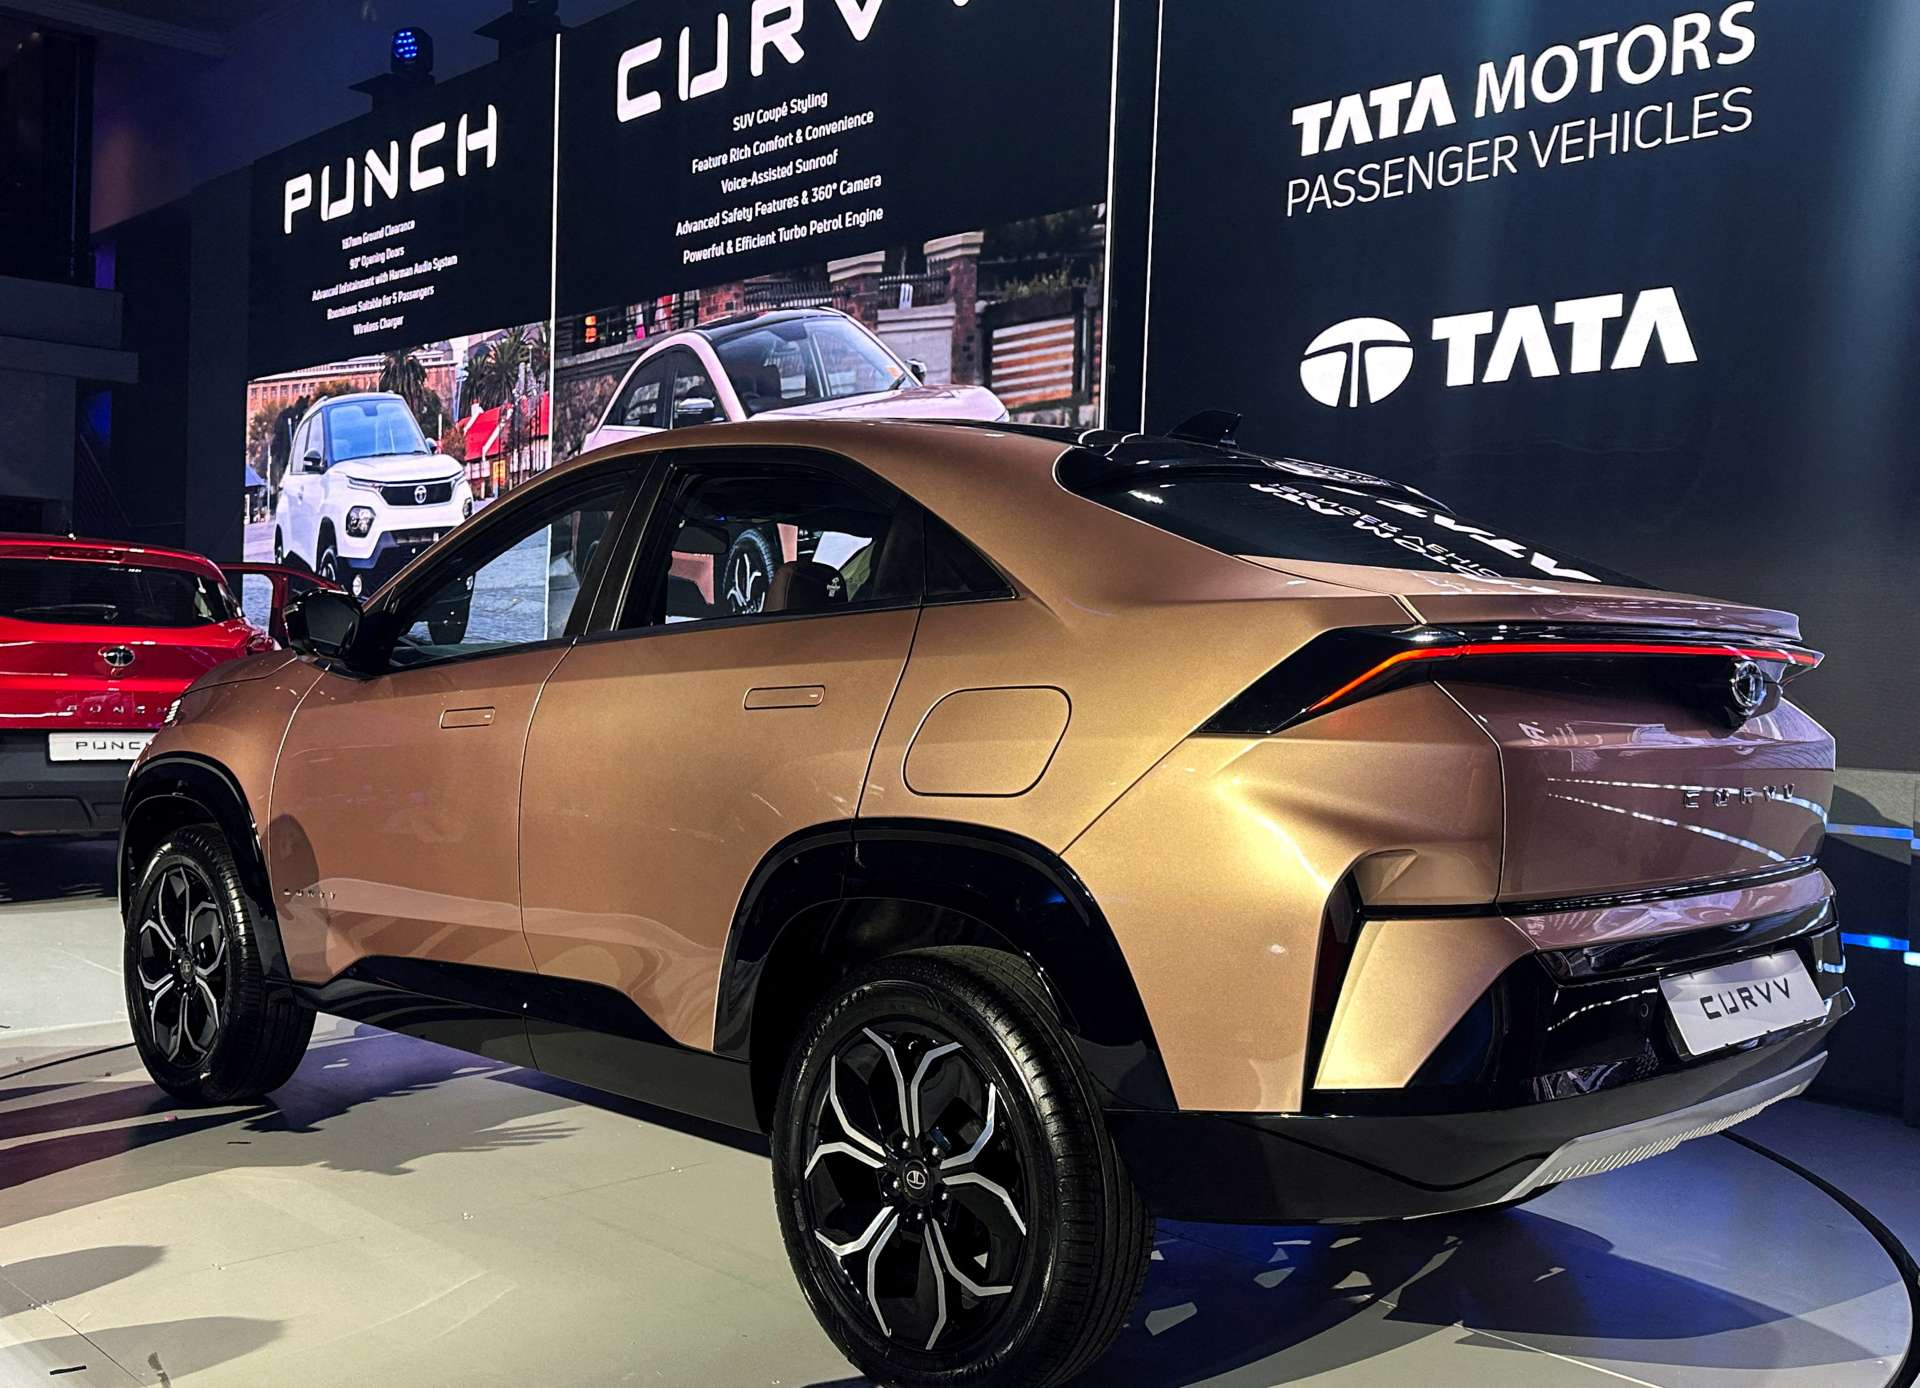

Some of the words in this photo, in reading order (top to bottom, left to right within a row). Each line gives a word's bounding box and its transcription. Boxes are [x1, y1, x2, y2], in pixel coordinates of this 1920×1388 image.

[617, 0, 971, 123] CURV
[1292, 73, 1457, 157] TATA
[1474, 0, 1756, 119] MOTORS
[733, 111, 755, 131] SUV
[756, 101, 788, 124] Coupé
[790, 92, 828, 114] Styling
[692, 153, 728, 174] Feature
[729, 144, 751, 163] Rich
[752, 132, 794, 156] Comfort
[795, 128, 803, 144] &
[805, 111, 874, 141] Convenience
[1287, 134, 1519, 217] PASSENGER
[1529, 86, 1753, 168] VEHICLES
[284, 104, 498, 234] PUNCH
[721, 160, 793, 194] Voice-Assisted
[795, 148, 839, 174] Sunroof
[676, 212, 720, 237] Advanced
[721, 207, 753, 225] Safety
[754, 195, 799, 217] Features
[801, 190, 809, 206] &
[811, 182, 838, 203] 360°
[839, 174, 882, 196] Camera
[362, 227, 385, 244] Ground
[384, 219, 416, 237] Clearance
[683, 241, 725, 265] Powerful
[726, 239, 734, 255] &
[735, 233, 777, 253] Efficient
[777, 224, 808, 243] Turbo
[809, 213, 843, 236] Petrol
[845, 207, 884, 228] Engine
[361, 251, 385, 269] Opening
[385, 246, 405, 260] Doors
[388, 266, 414, 282] Harman
[413, 261, 433, 275] Audio
[432, 254, 458, 272] System
[382, 294, 393, 307] for
[392, 292, 398, 305] 5
[353, 320, 380, 336] Wireless
[379, 315, 405, 330] Charger
[1431, 286, 1698, 388] TATA
[75, 741, 148, 751] PUNC
[1699, 977, 1791, 1020] CURVV
